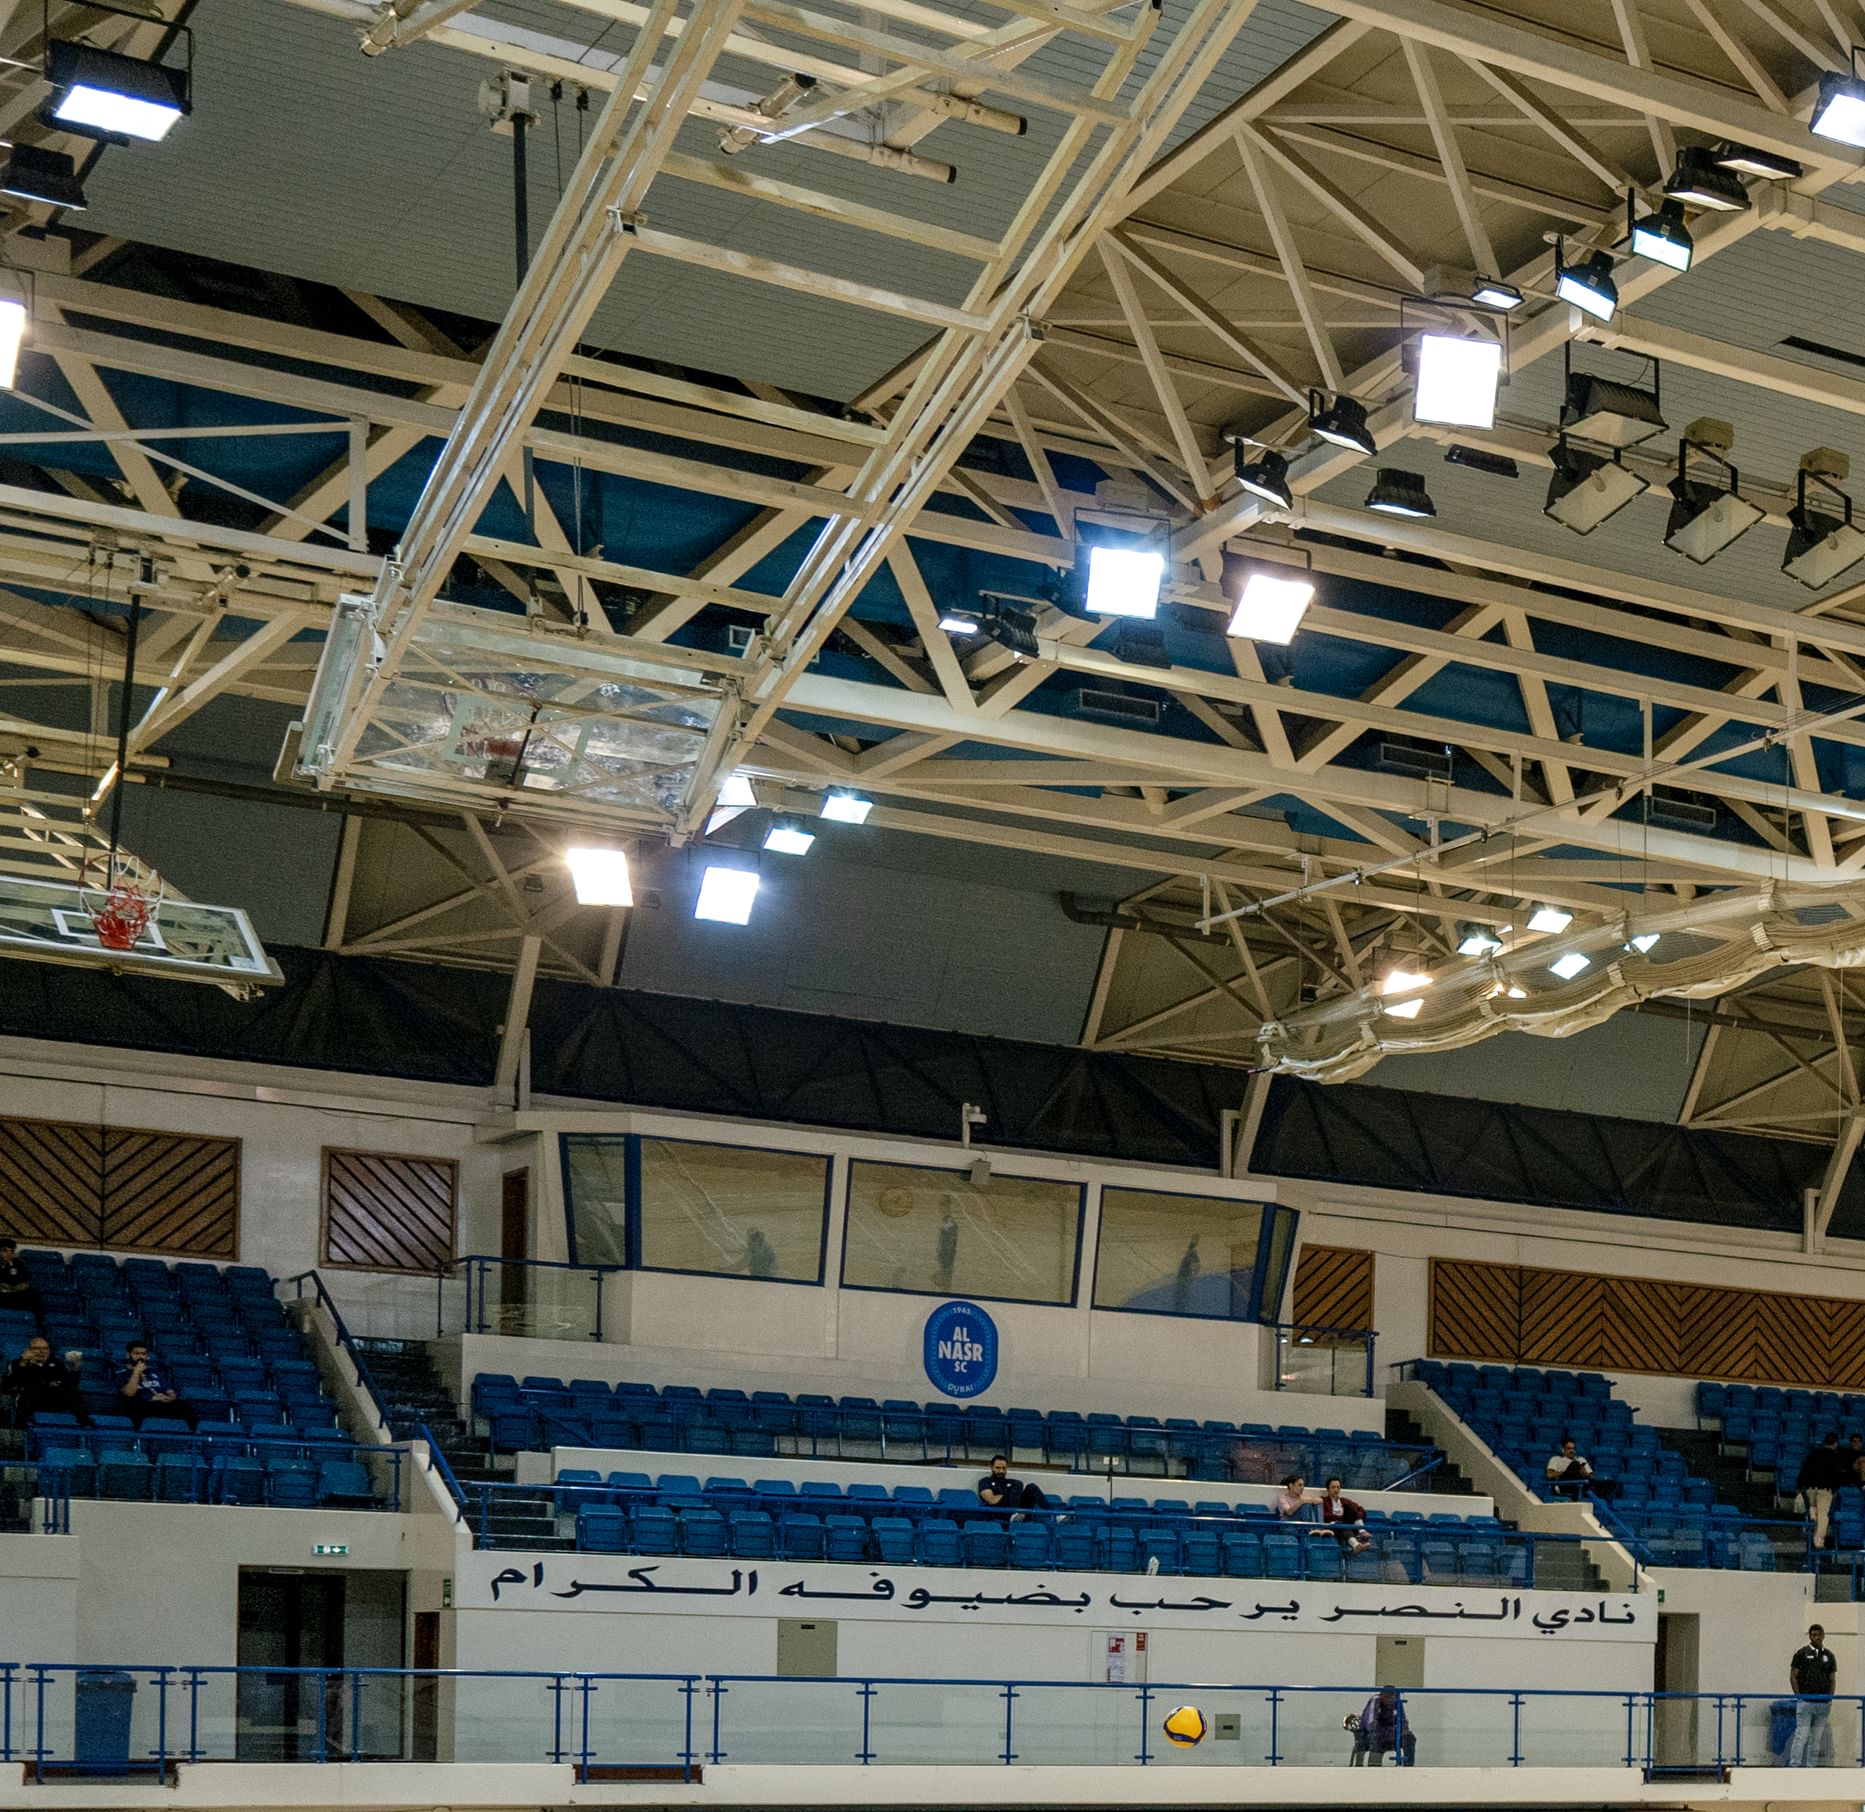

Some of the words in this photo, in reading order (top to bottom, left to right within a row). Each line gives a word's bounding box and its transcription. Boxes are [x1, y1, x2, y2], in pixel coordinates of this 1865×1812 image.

[953, 1326, 970, 1342] AL
[938, 1340, 983, 1362] NASR
[954, 1361, 968, 1373] SC
[490, 1560, 758, 1602] الكرام
[778, 1570, 1091, 1614] بضيوفه
[1109, 1591, 1302, 1621] يرحب
[1318, 1596, 1521, 1622] النصر
[1531, 1600, 1636, 1636] نادي
